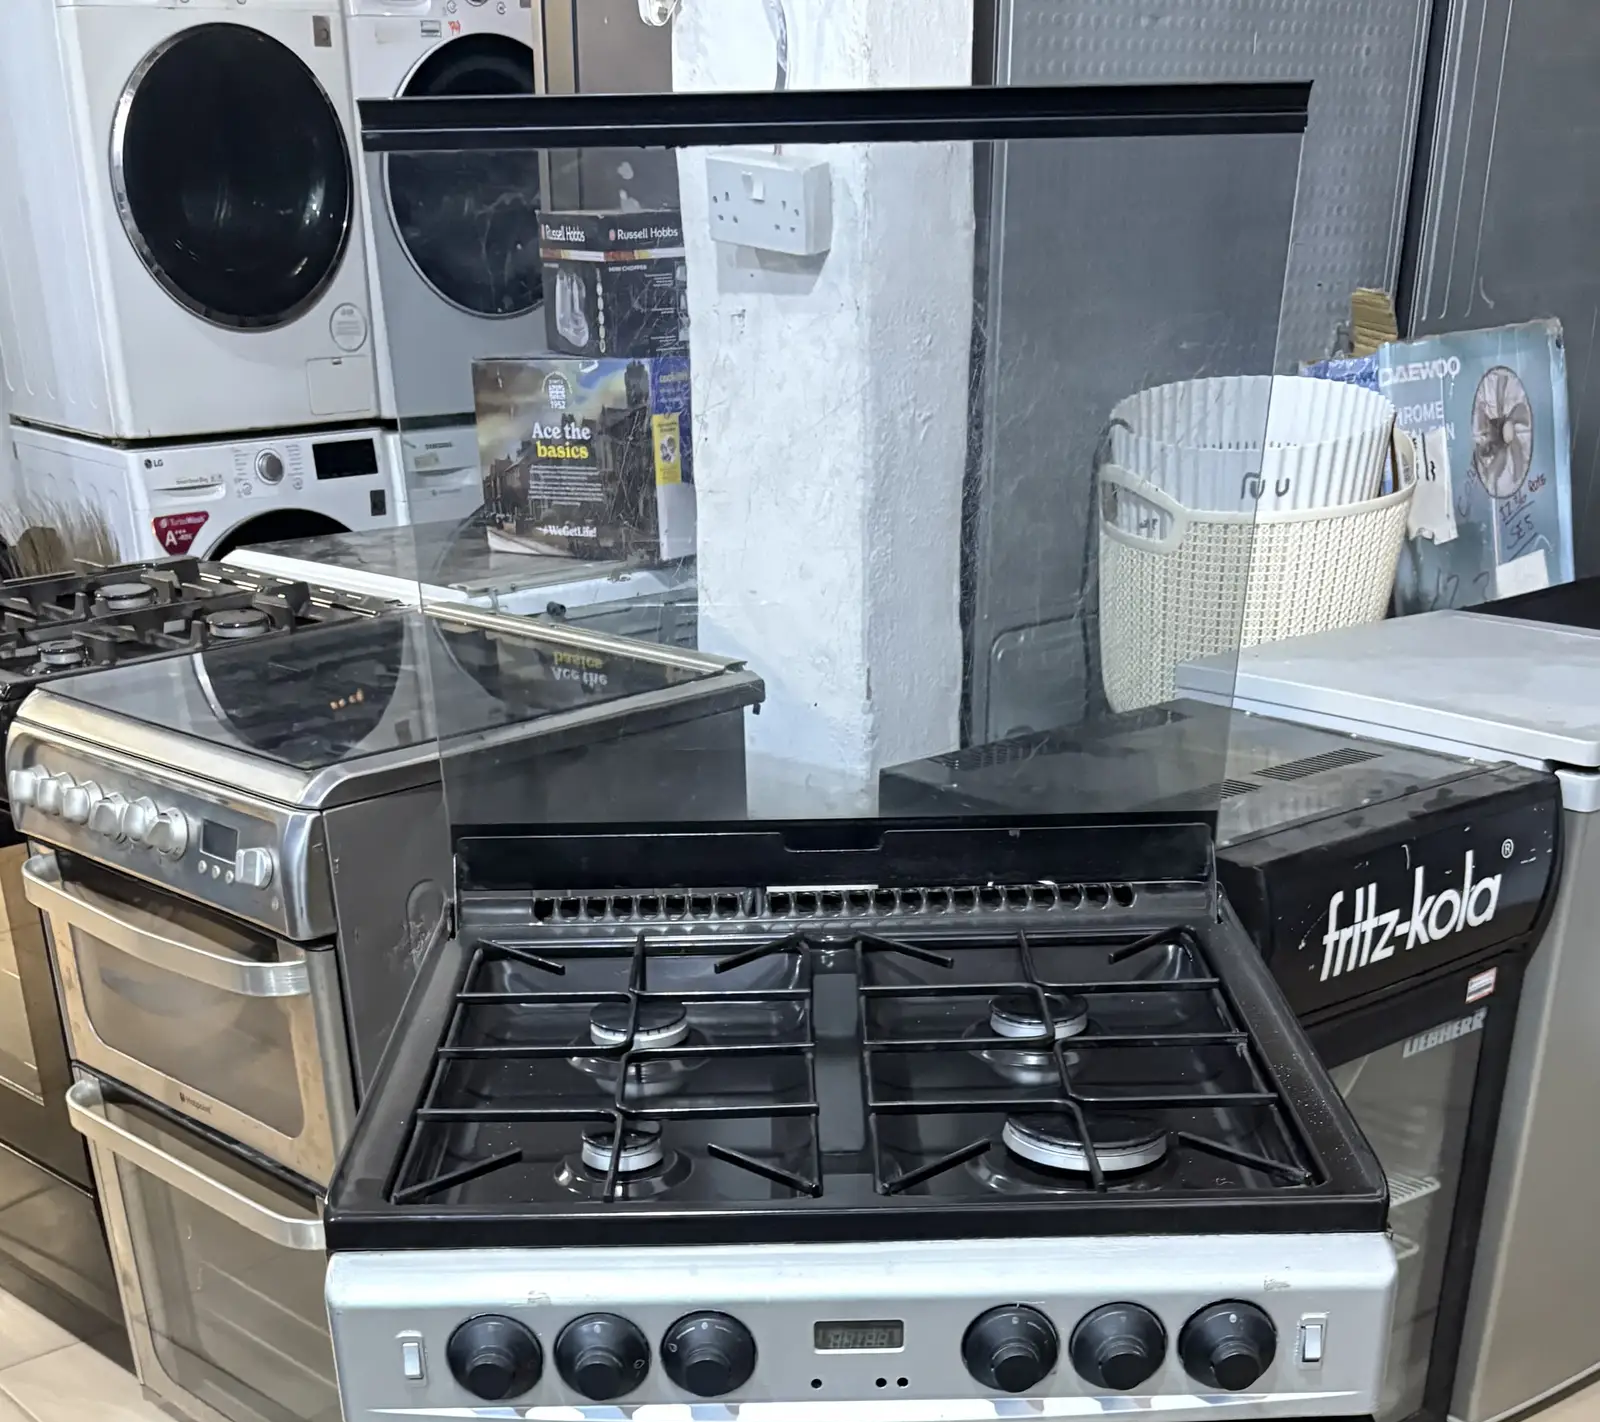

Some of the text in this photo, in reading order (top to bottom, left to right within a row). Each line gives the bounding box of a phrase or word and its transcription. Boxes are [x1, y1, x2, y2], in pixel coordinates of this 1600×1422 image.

[545, 225, 585, 242] Russell Hobbs
[617, 226, 679, 240] Russell Hobbs
[1379, 356, 1460, 388] DAEWOO
[532, 422, 591, 440] Ace the
[536, 441, 589, 459] basics
[153, 459, 164, 467] LG
[1320, 850, 1502, 982] fritz-kola
[1402, 1006, 1488, 1059] LIEBHERR
